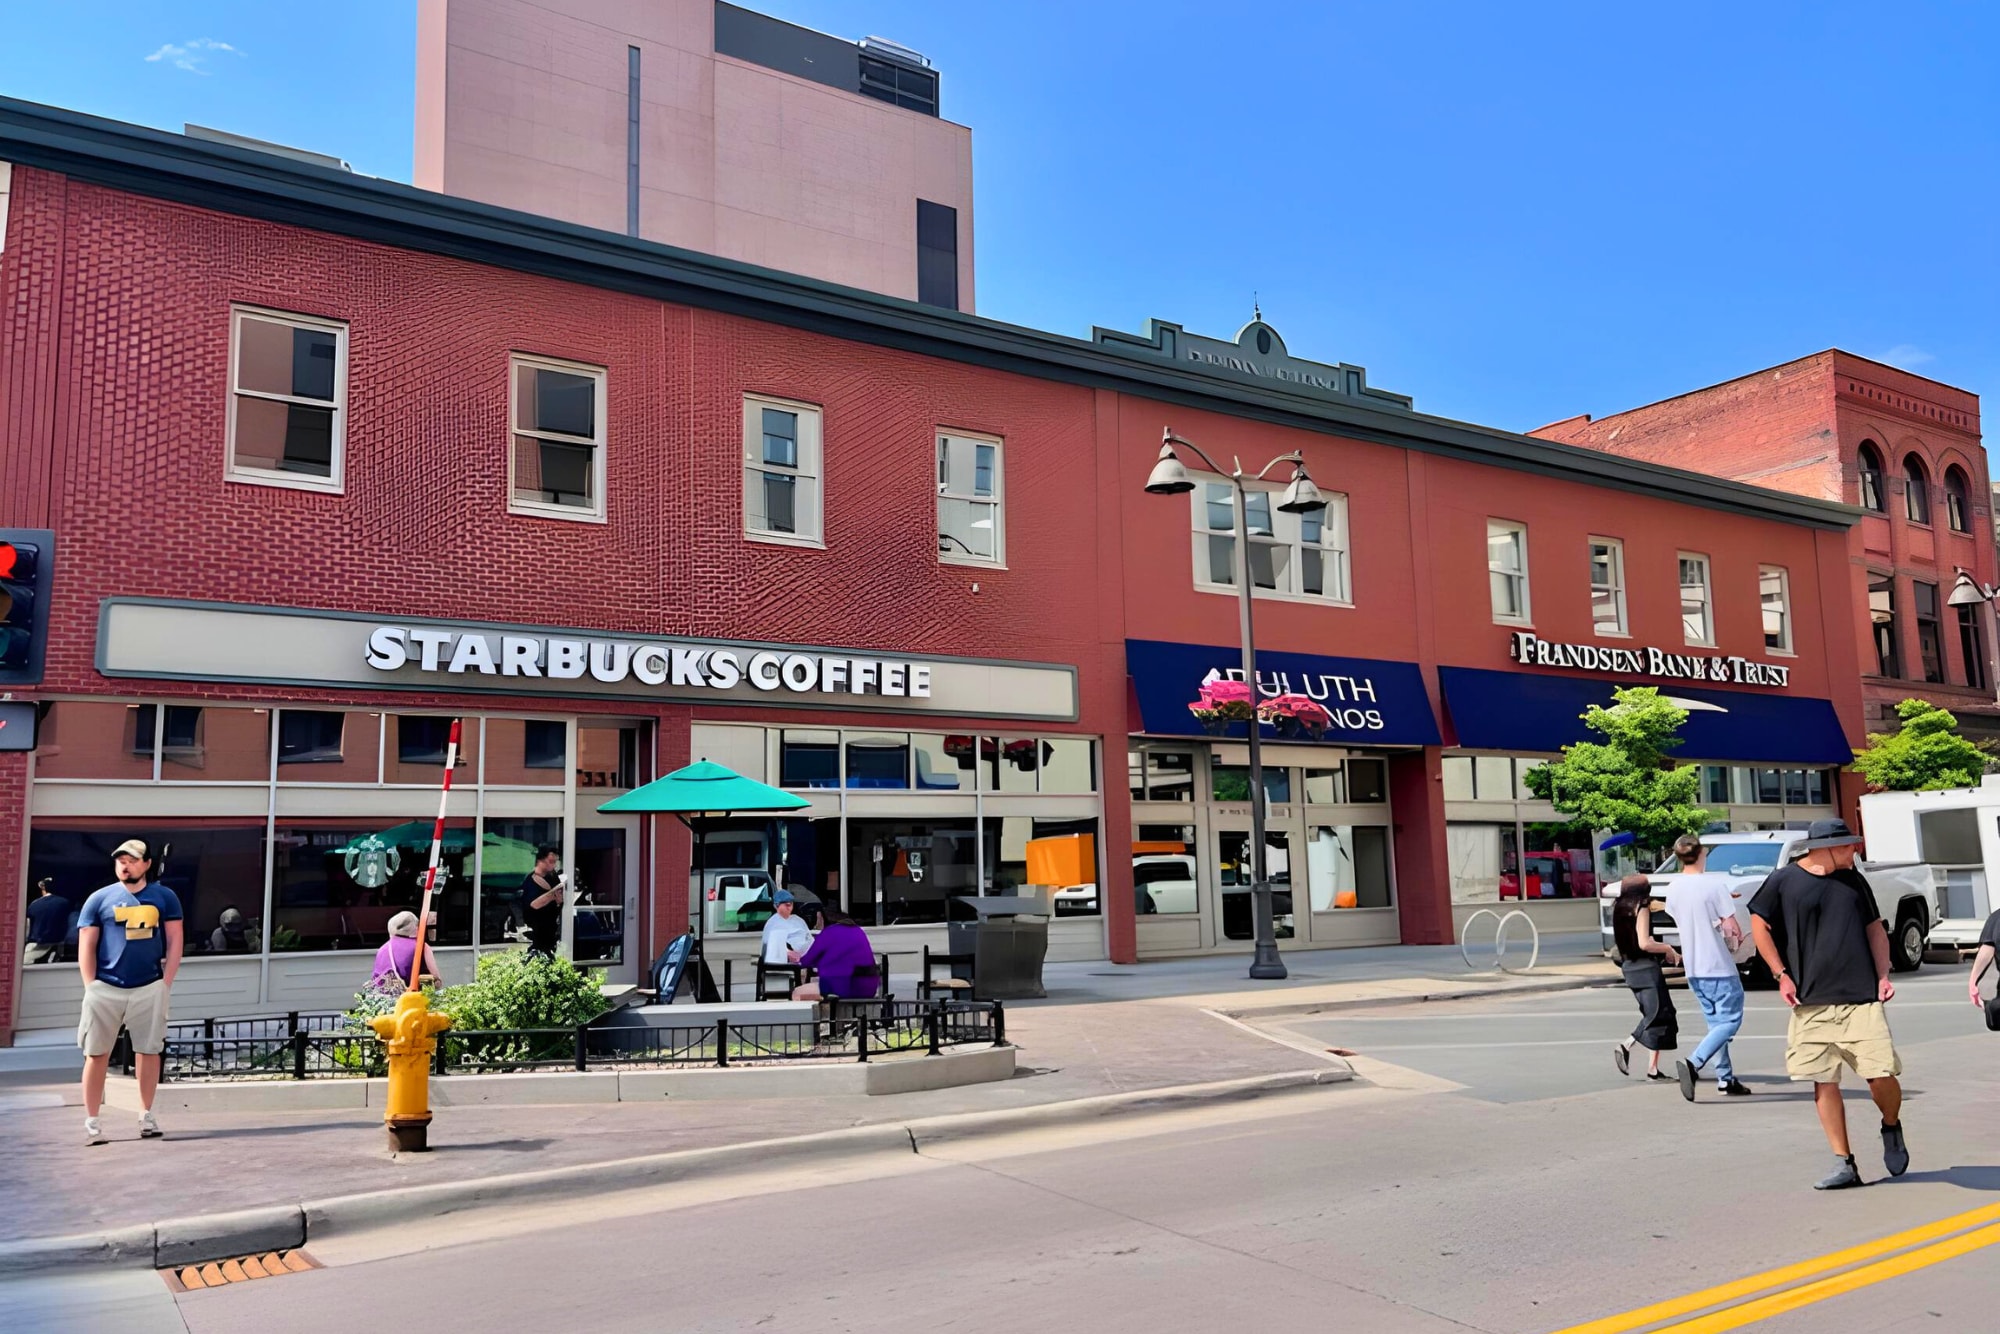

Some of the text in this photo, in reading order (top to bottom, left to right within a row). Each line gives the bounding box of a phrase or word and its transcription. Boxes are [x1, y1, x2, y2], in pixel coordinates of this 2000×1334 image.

[365, 627, 931, 698] STARBUCKS COFFEE
[1709, 656, 1729, 682] &
